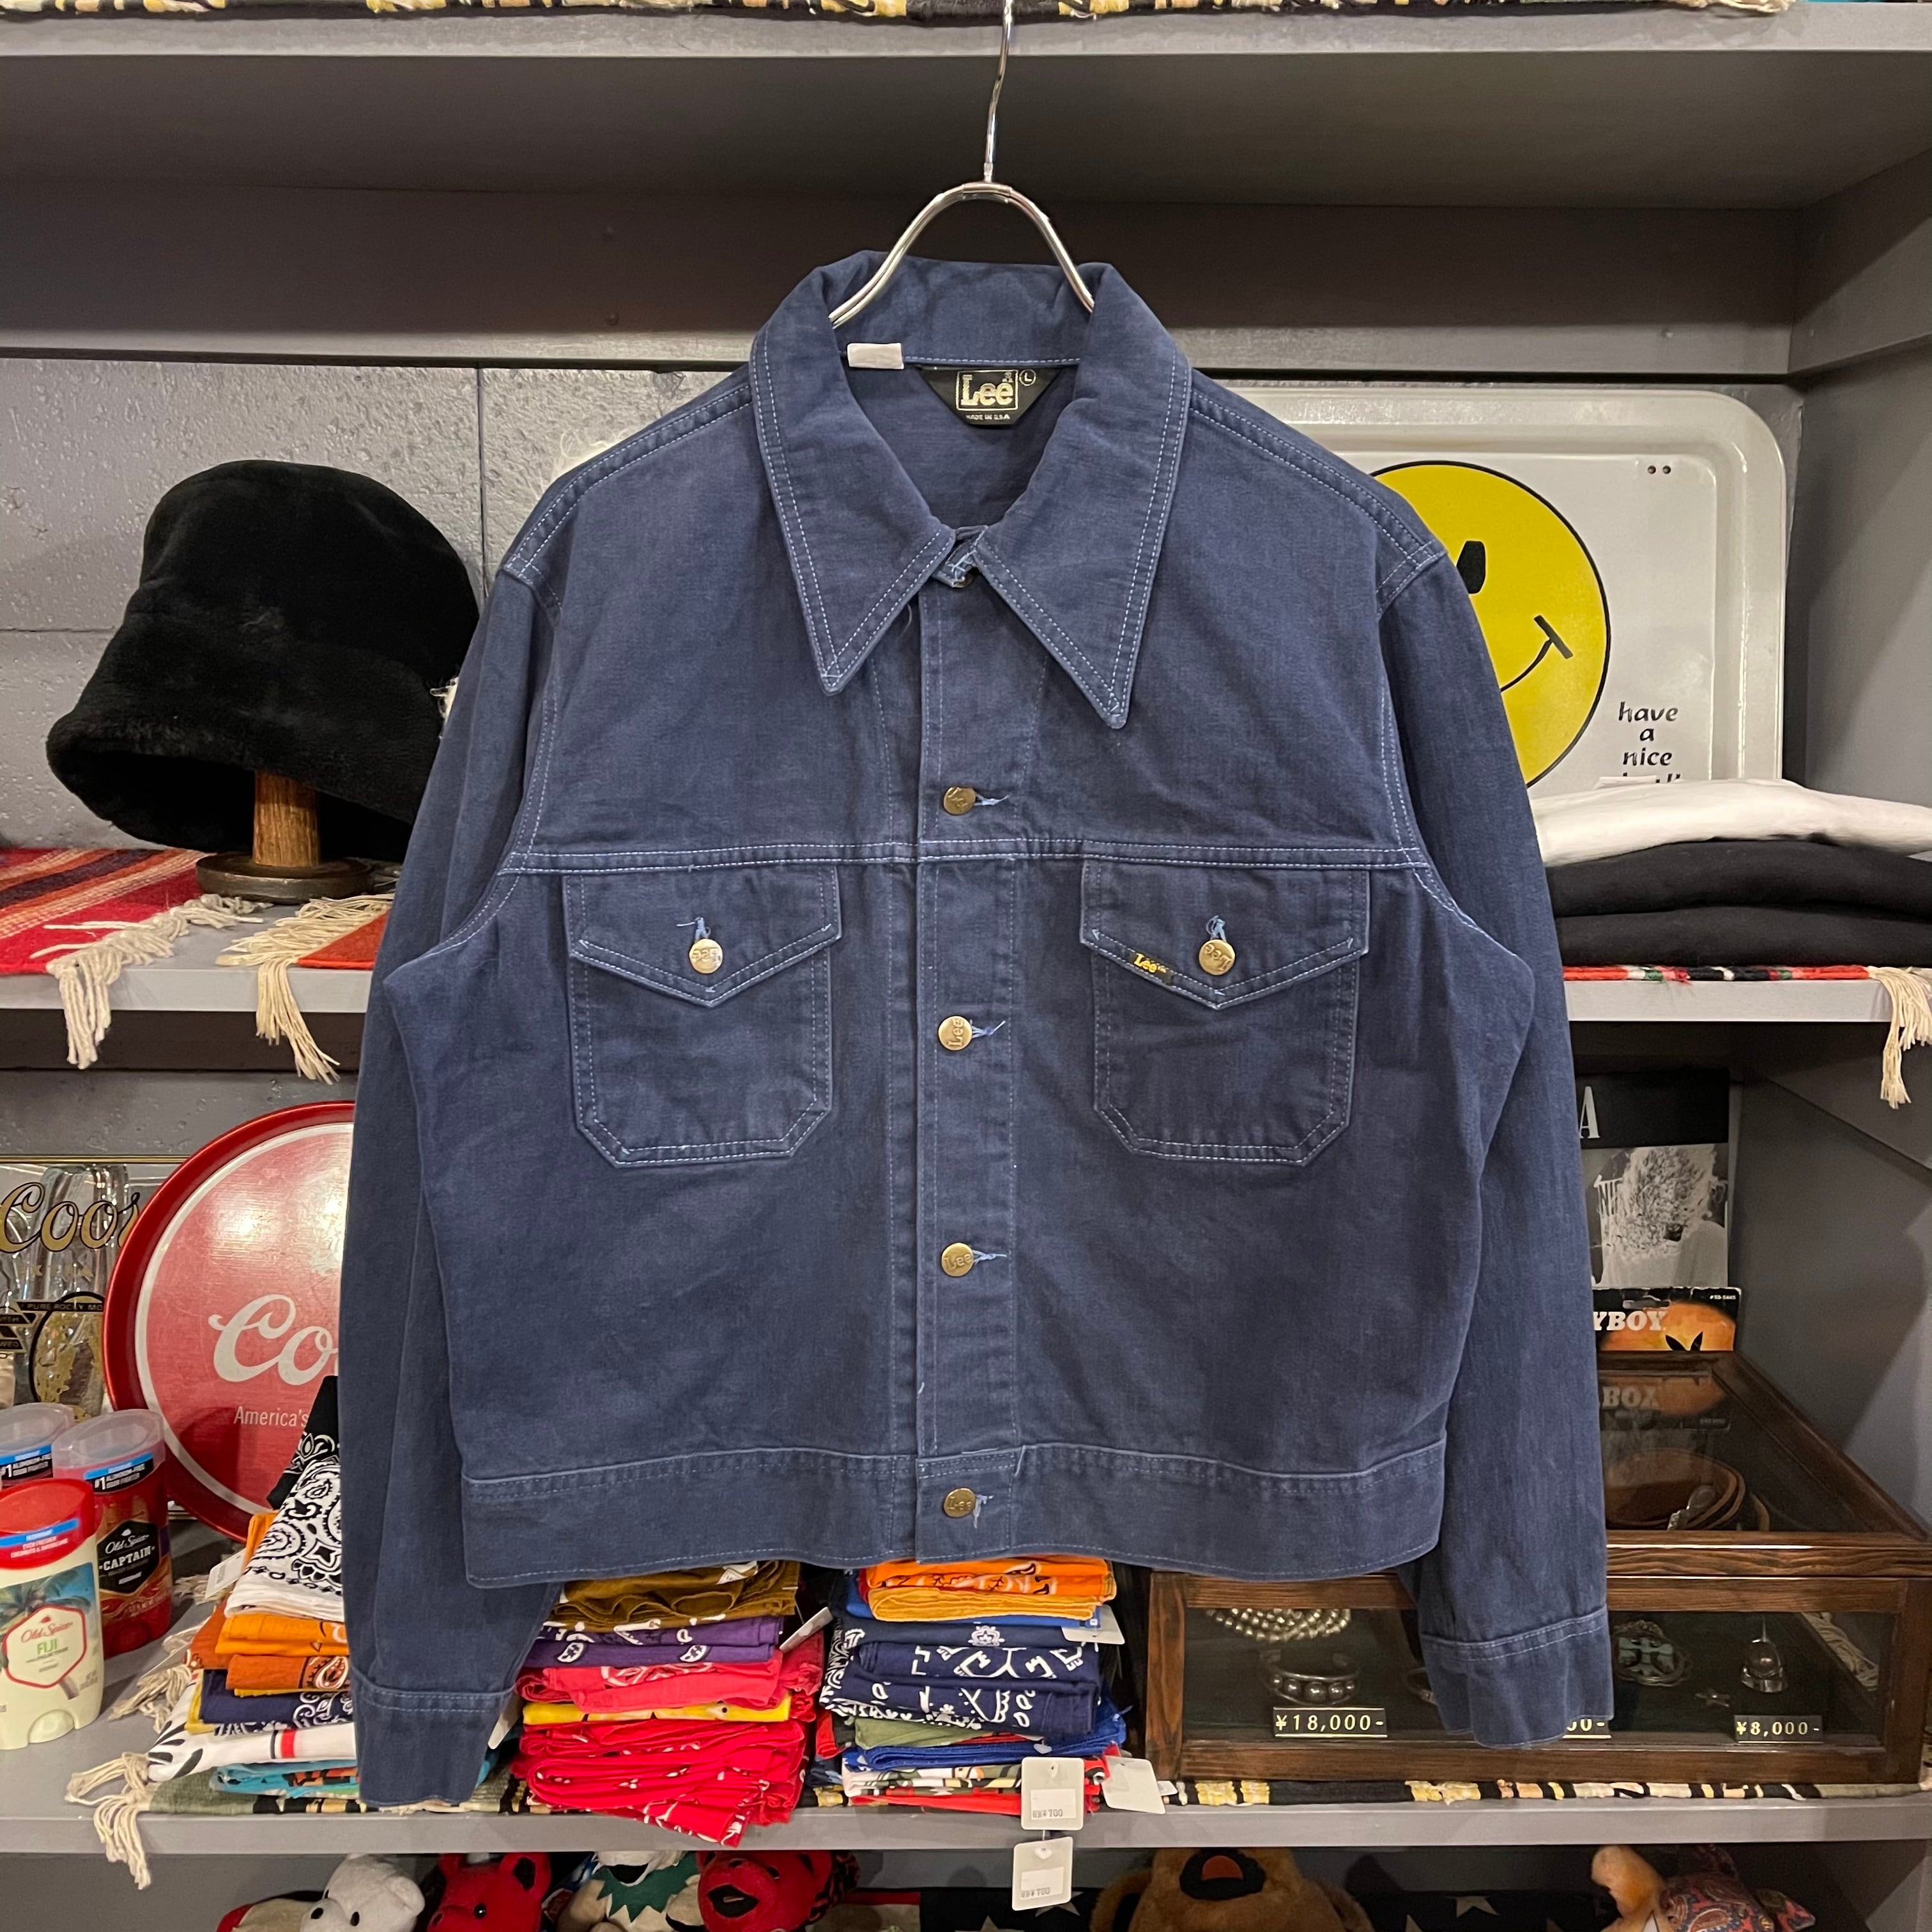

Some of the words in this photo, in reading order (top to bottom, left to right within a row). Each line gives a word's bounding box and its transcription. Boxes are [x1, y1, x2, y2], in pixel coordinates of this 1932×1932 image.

[960, 374, 1014, 406] Lee
[1618, 701, 1679, 723] have
[1639, 728, 1654, 742] a
[1623, 747, 1673, 766] nice
[1133, 953, 1158, 974] Lee
[948, 1018, 963, 1046] Lee
[1579, 1086, 1600, 1138] A
[944, 1254, 972, 1270] Lee
[208, 1294, 339, 1385] Co
[234, 1406, 309, 1427] America's
[105, 1540, 125, 1554] Old
[103, 1545, 151, 1571] CAPTAIN
[21, 1629, 43, 1643] Old
[36, 1638, 58, 1656] FIJI
[1275, 1714, 1384, 1732] ¥18,000-
[1736, 1721, 1820, 1737] ¥8,000-
